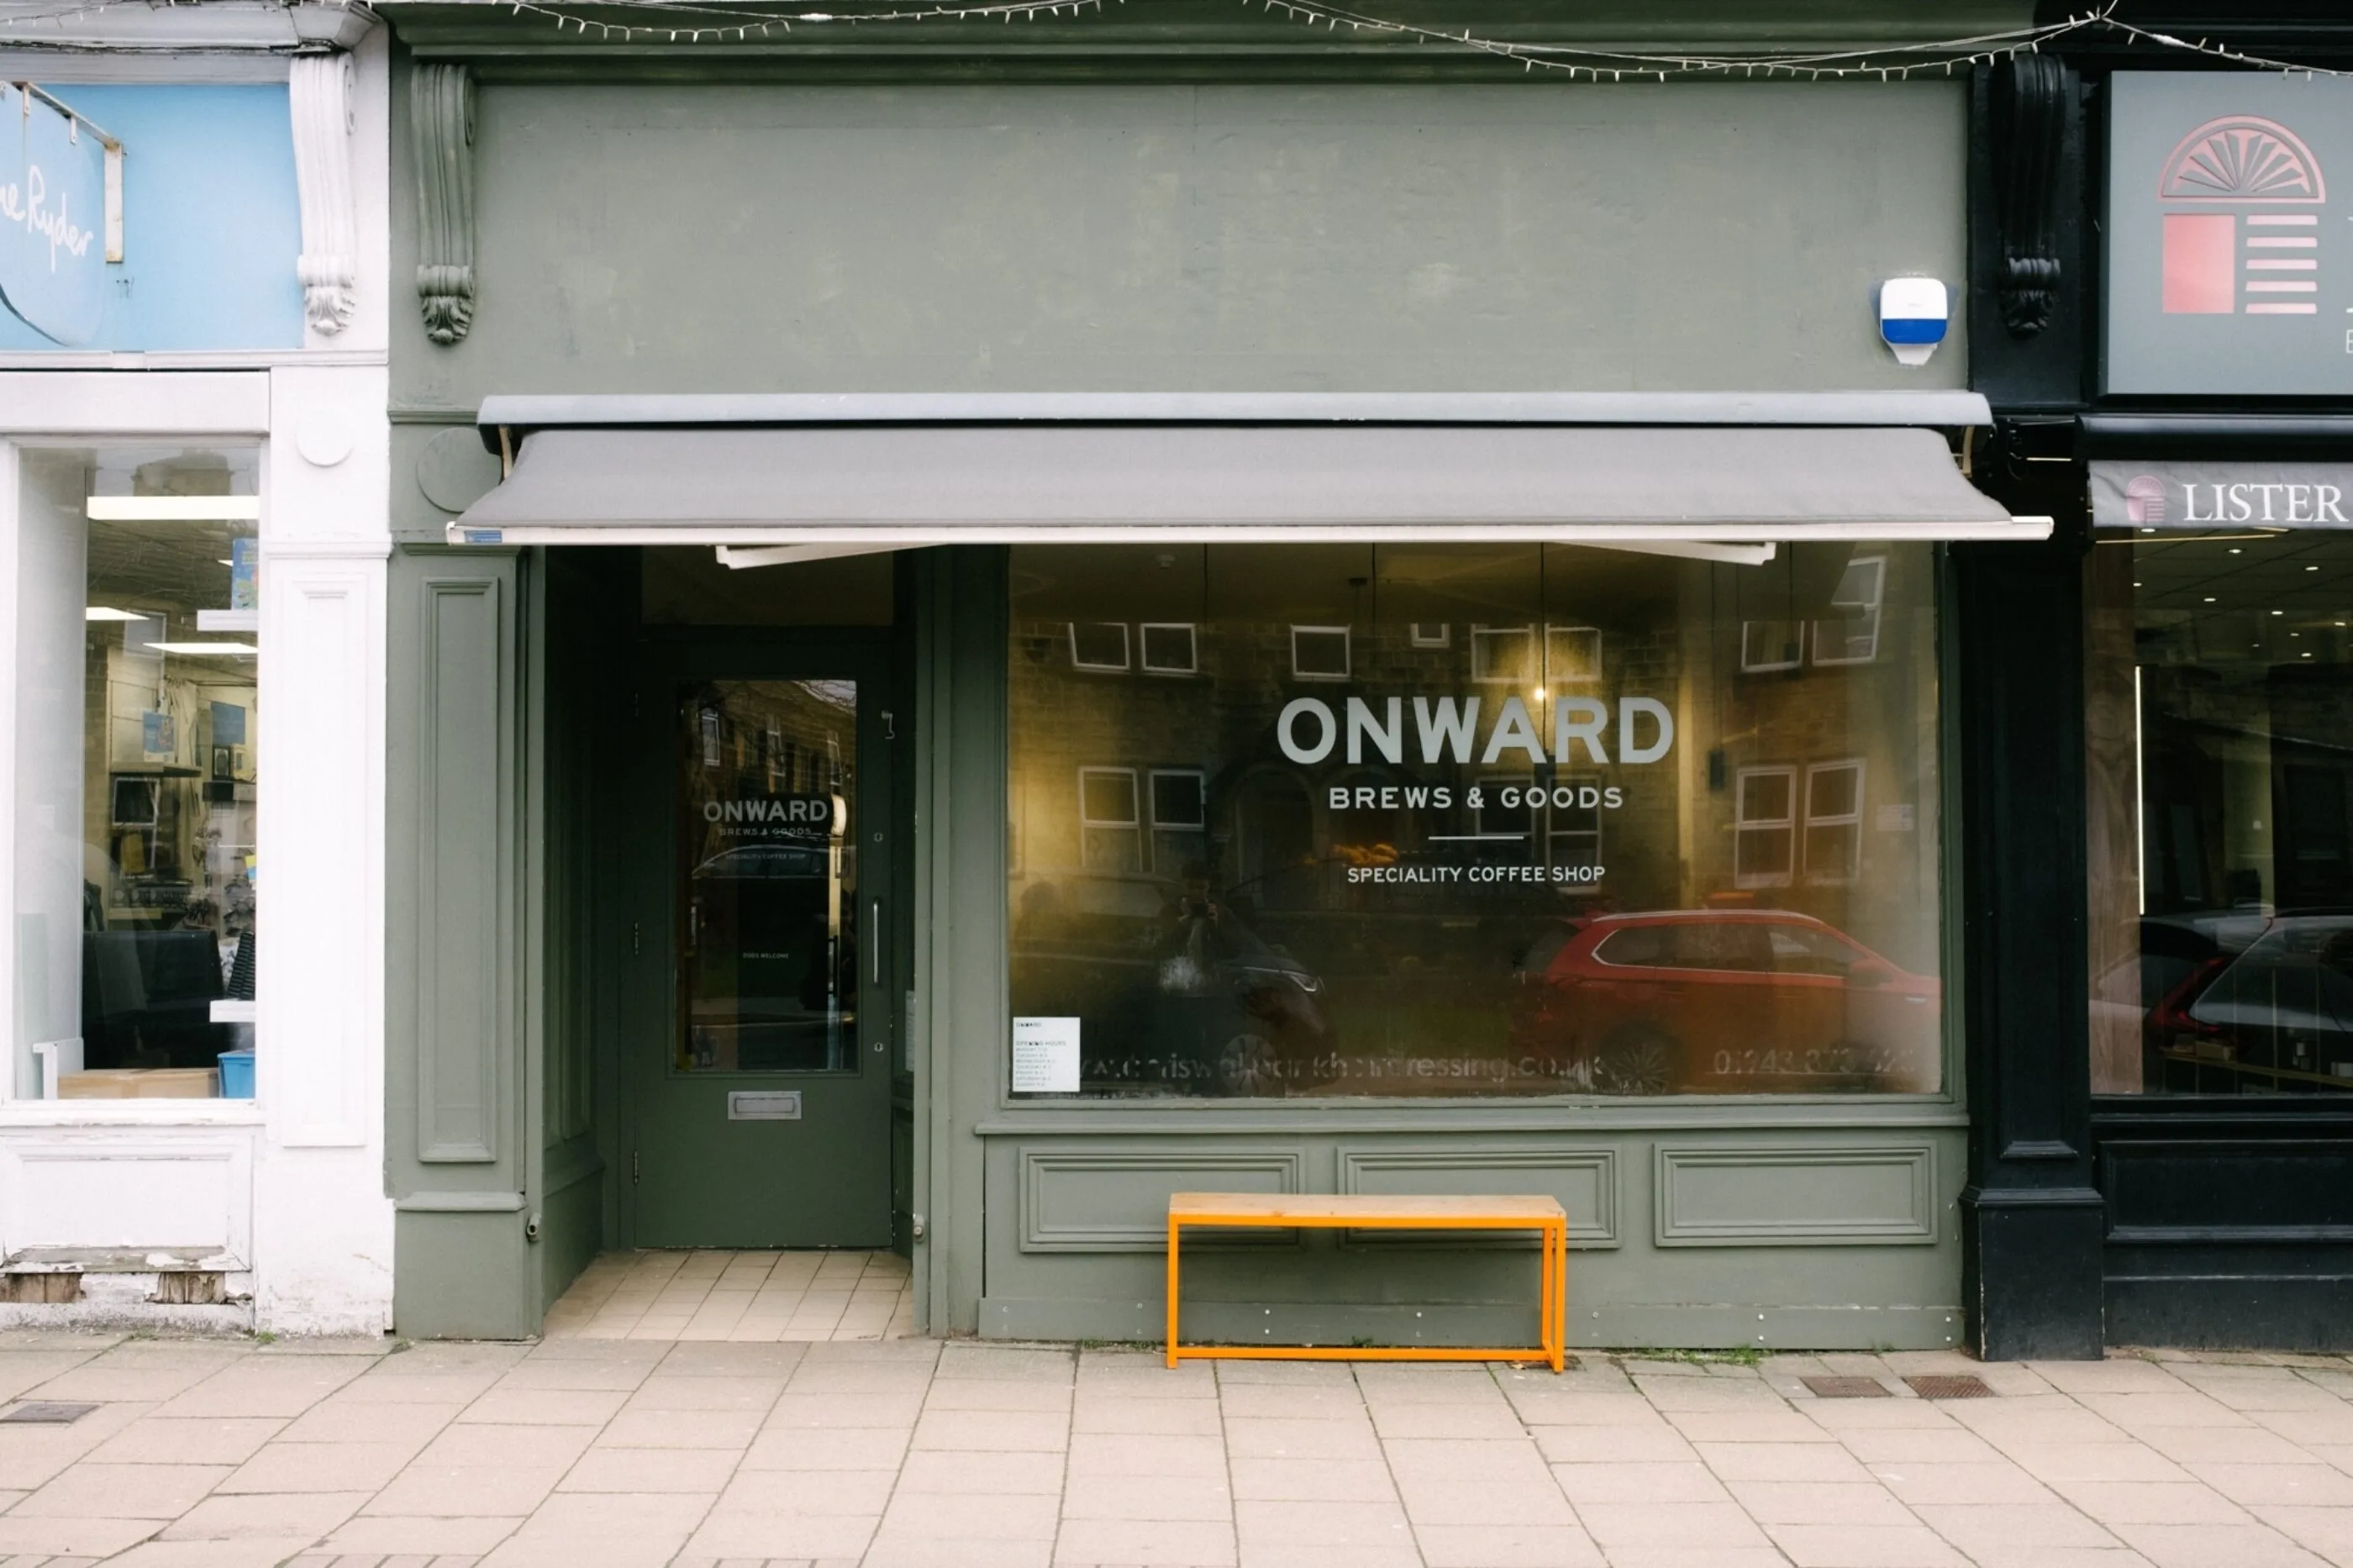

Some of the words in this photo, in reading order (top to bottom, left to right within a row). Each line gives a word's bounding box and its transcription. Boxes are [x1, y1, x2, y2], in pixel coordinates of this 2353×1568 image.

[27, 165, 94, 274] Ryder
[2182, 483, 2350, 522] LISTER
[1277, 696, 1674, 765] ONWARD
[1329, 787, 1452, 809] BREWS
[1466, 787, 1485, 808] &
[1501, 787, 1624, 808] GOODS
[703, 799, 828, 822] ONWARD
[720, 827, 758, 836] BREWS
[772, 827, 812, 836] GOODS
[1348, 867, 1463, 883] SPECIALITY
[1468, 866, 1546, 882] COFFEE
[1552, 866, 1606, 881] SHOP
